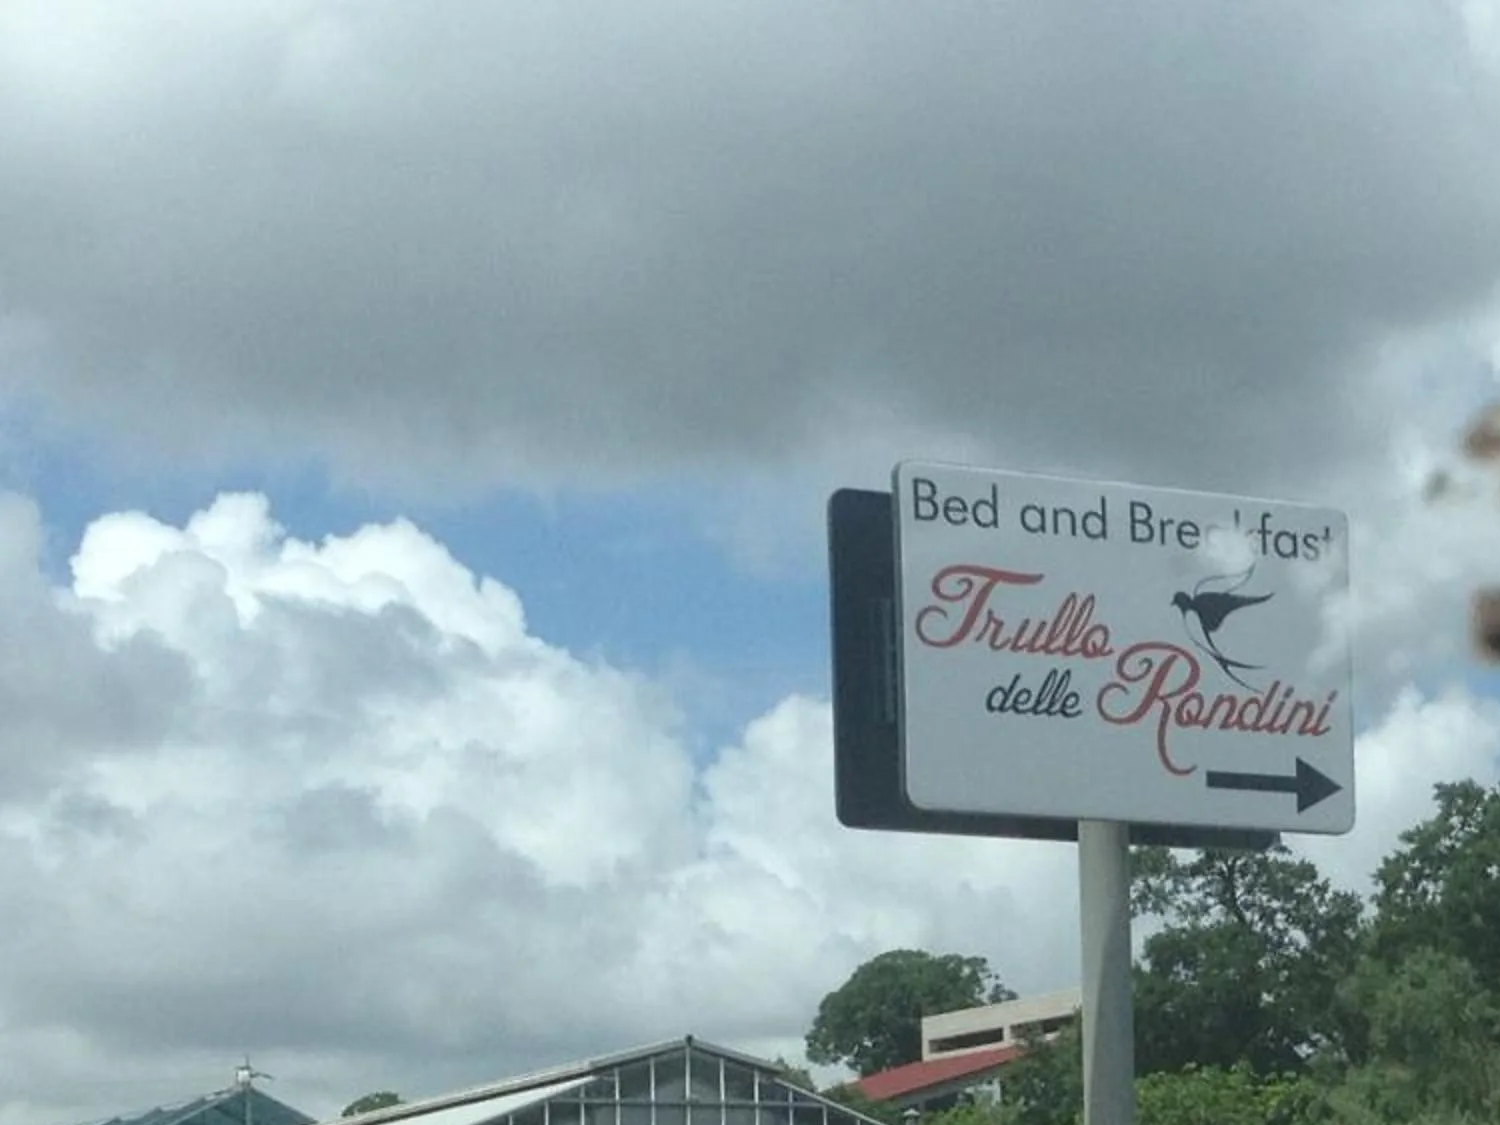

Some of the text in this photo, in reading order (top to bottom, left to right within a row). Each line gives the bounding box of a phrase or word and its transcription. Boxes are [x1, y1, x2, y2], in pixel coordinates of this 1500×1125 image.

[912, 478, 1333, 562] Bed and Brefast
[915, 564, 1113, 660] Trullo
[985, 641, 1338, 777] delle Rondini
